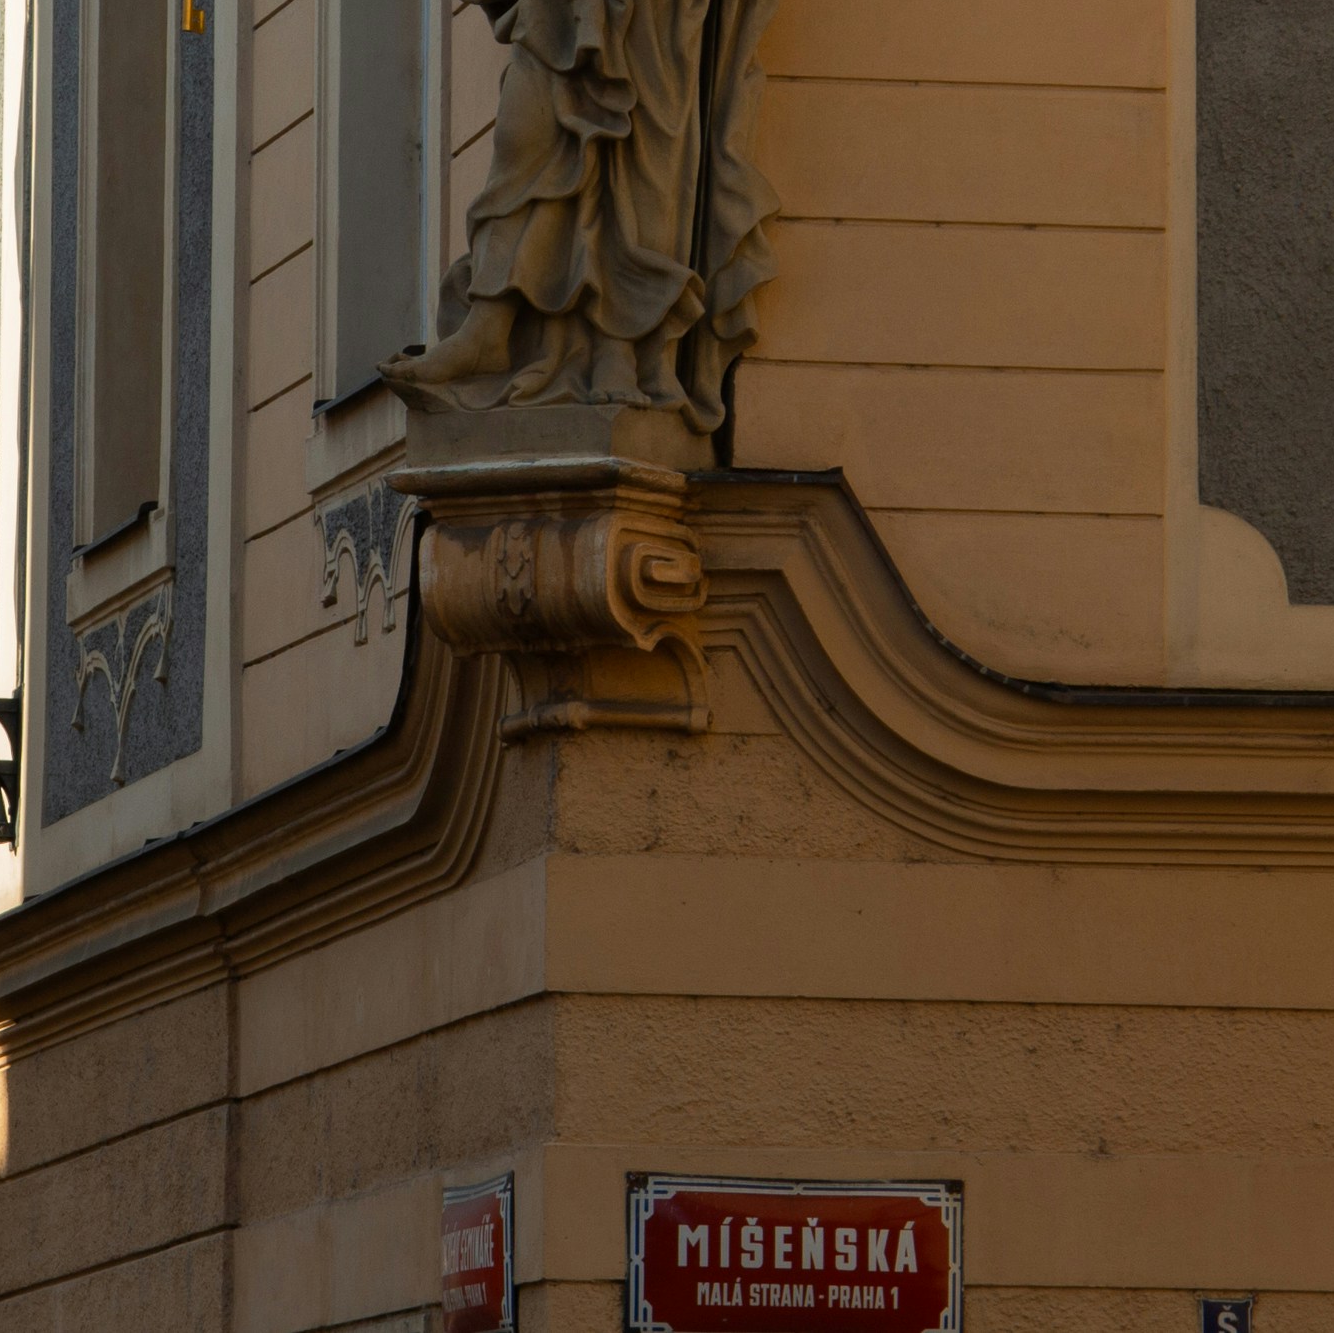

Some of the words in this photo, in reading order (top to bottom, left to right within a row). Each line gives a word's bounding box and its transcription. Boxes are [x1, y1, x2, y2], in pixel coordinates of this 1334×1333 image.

[677, 1217, 918, 1273] MÍŠEŇSKÁ
[697, 1277, 743, 1306] MALÁ
[749, 1283, 815, 1308] STRANA
[828, 1285, 886, 1309] PRAHA
[891, 1286, 899, 1309] 1
